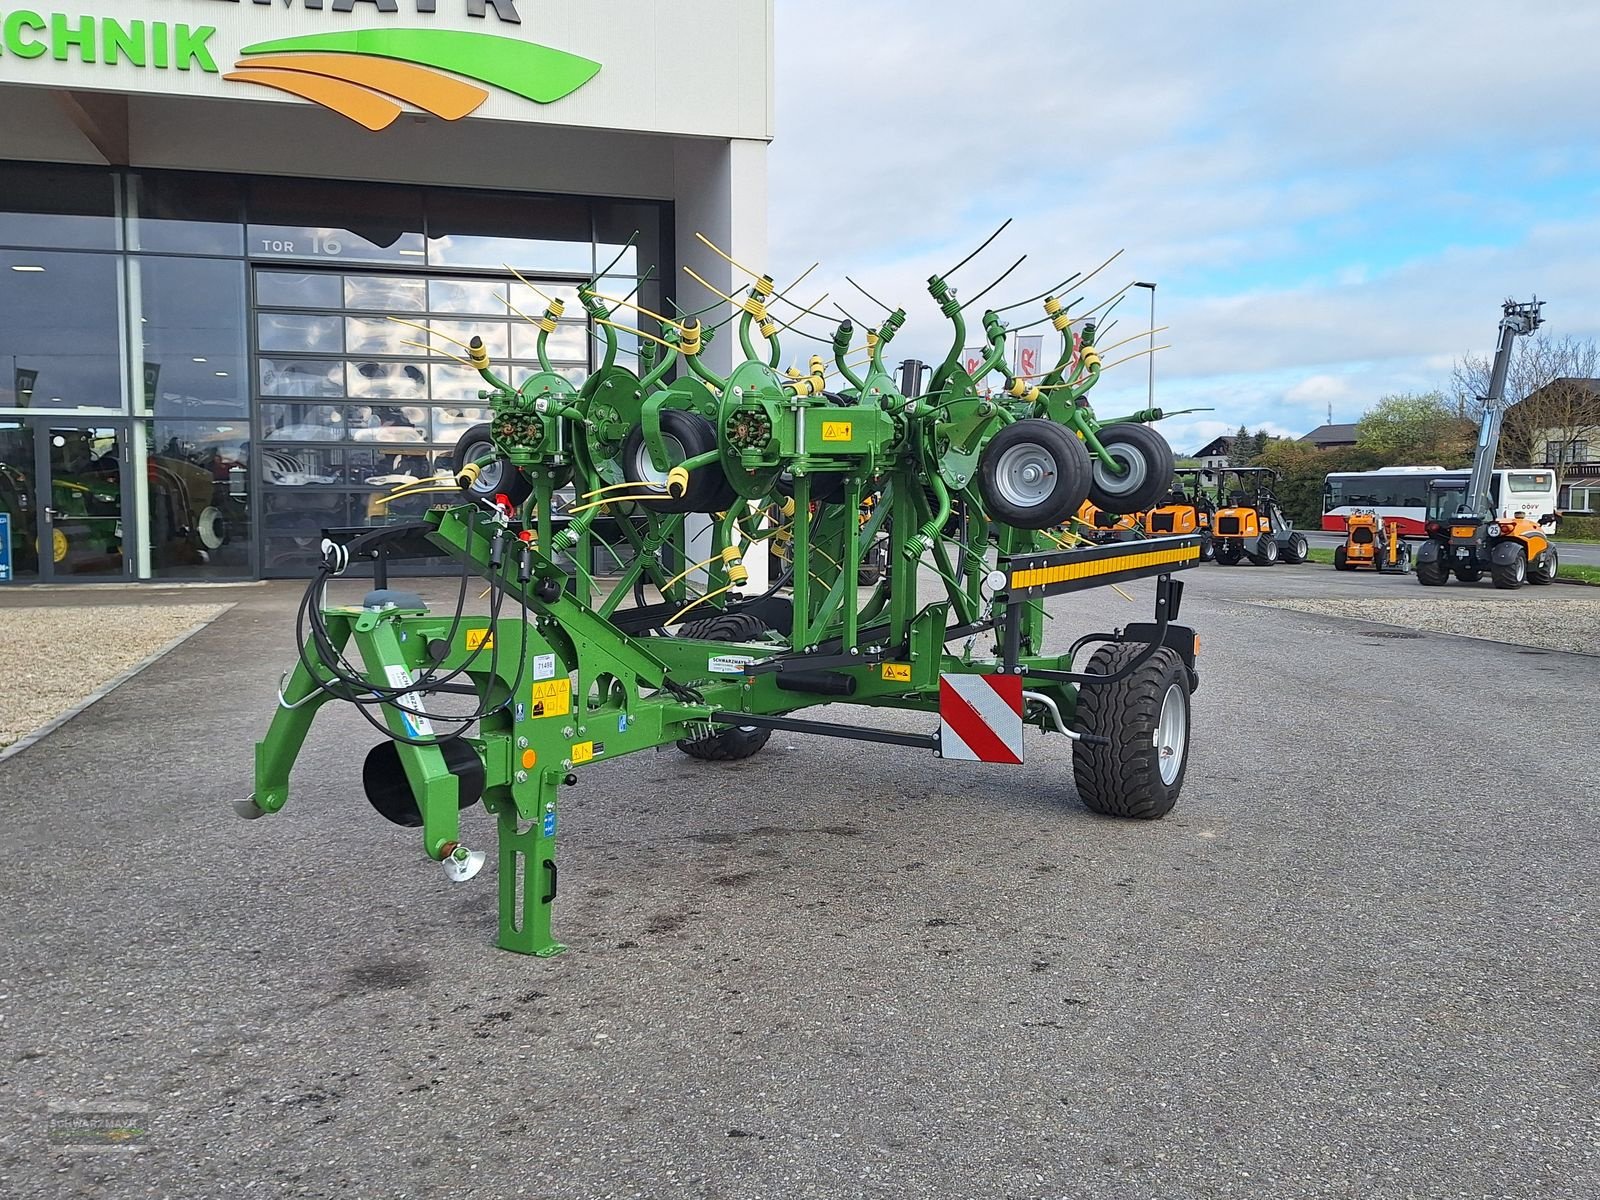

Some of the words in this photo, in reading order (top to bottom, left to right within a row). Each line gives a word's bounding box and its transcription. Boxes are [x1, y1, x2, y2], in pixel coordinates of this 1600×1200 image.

[0, 10, 219, 73] CHNIK
[262, 240, 294, 253] TOR
[1490, 526, 1499, 535] 25
